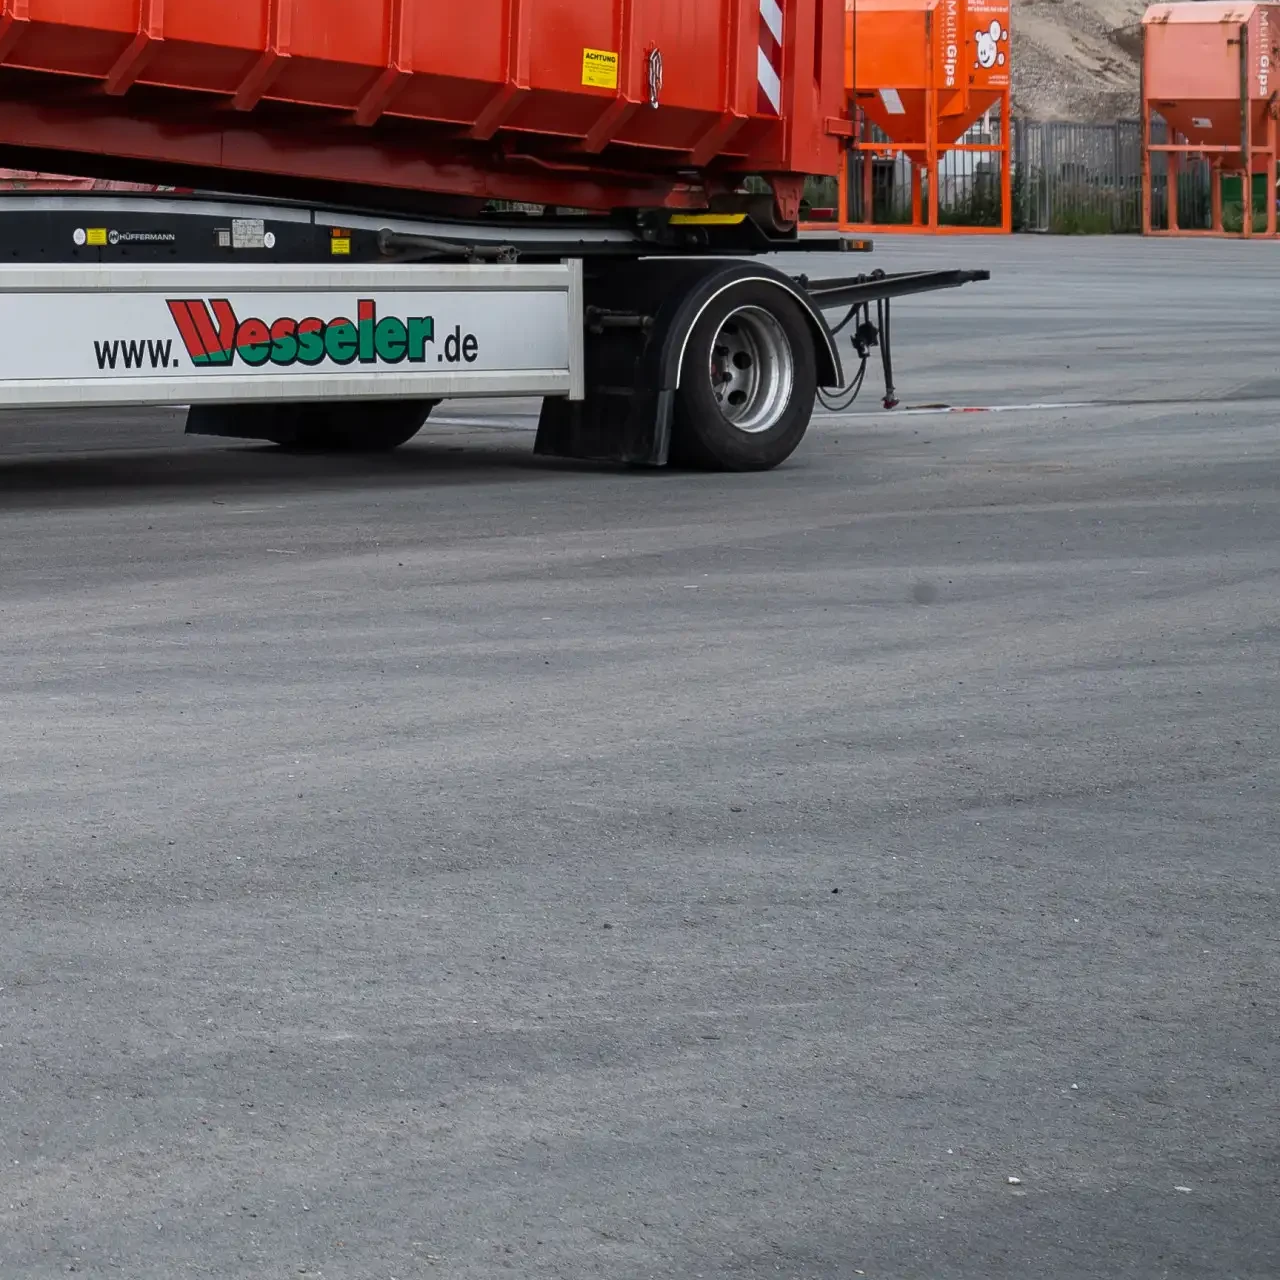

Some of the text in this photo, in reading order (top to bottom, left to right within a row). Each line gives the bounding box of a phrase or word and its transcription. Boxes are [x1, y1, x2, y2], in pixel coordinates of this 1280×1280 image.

[585, 52, 616, 63] ACHTUNG
[944, 0, 958, 87] MultiGips
[1256, 10, 1269, 97] MultiGips
[119, 232, 176, 241] HÜFFERMANN
[94, 298, 479, 370] www.Wesseler.de
